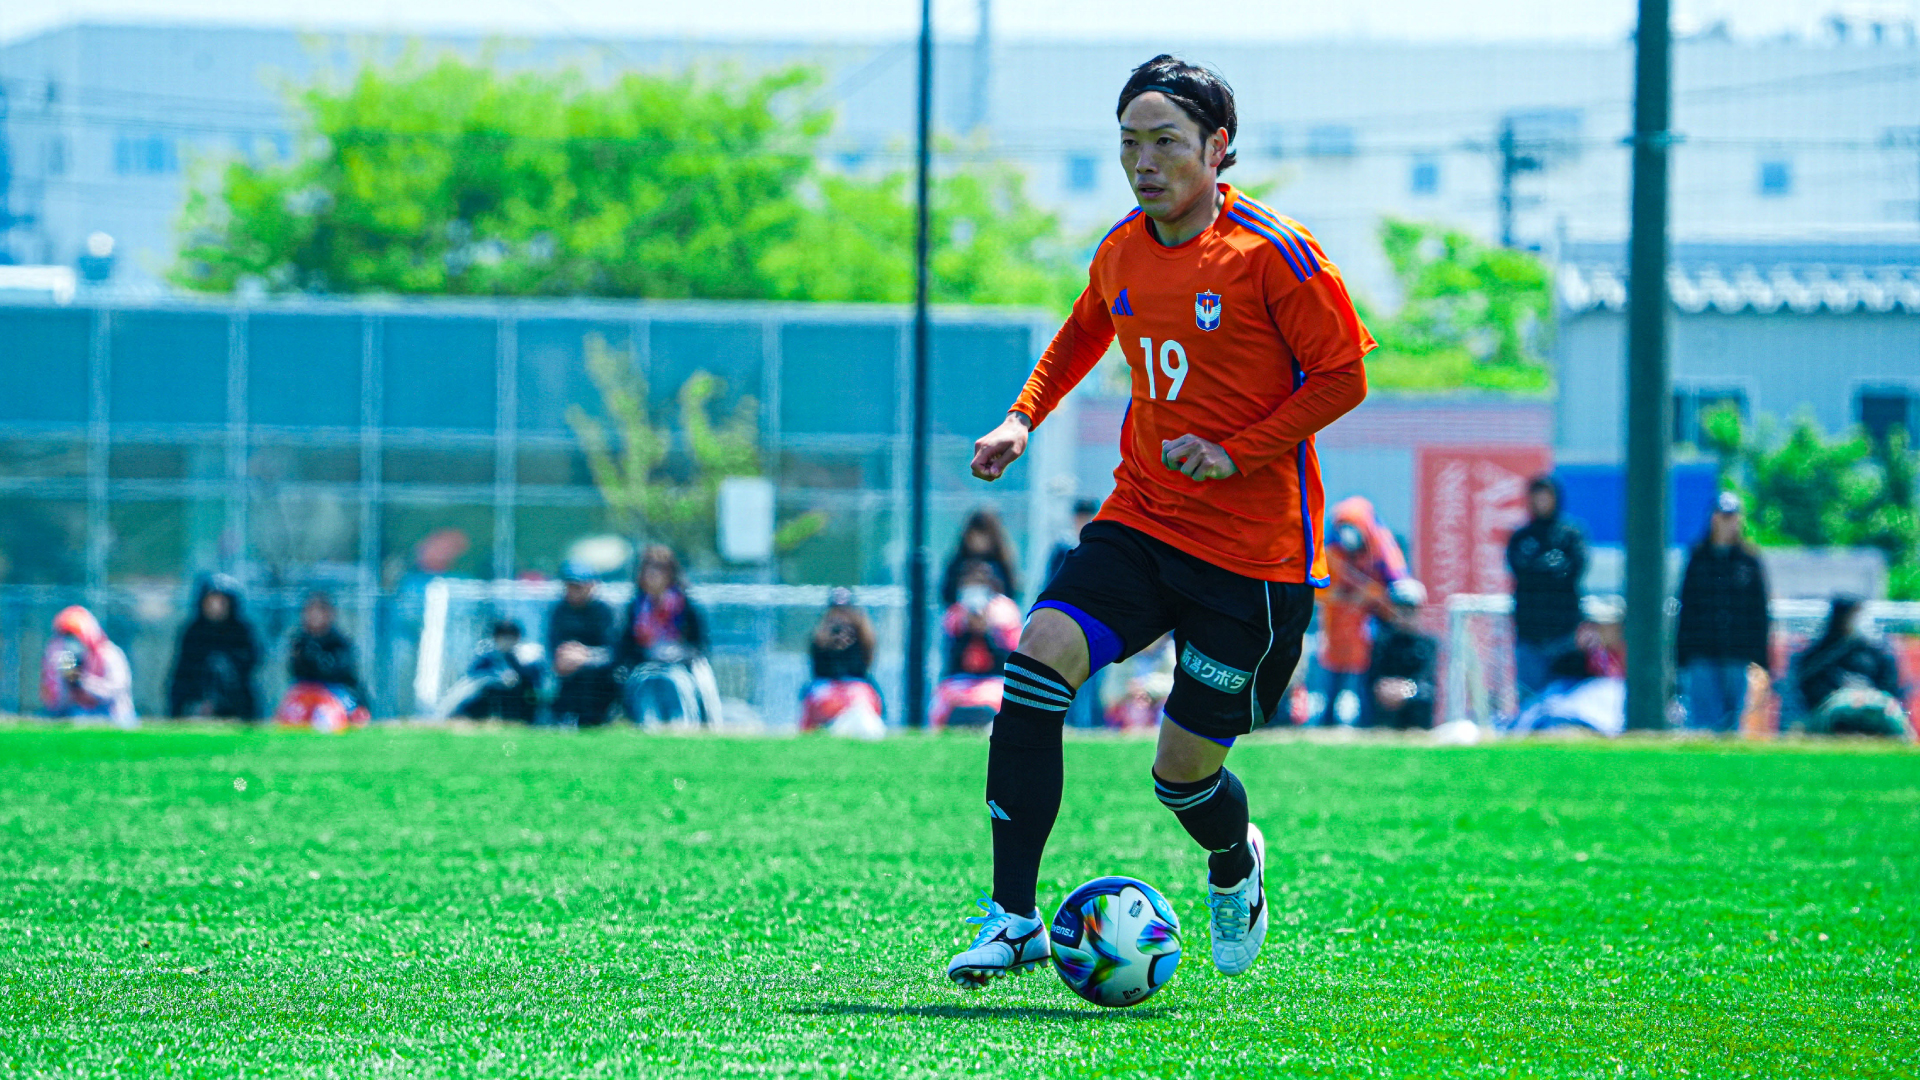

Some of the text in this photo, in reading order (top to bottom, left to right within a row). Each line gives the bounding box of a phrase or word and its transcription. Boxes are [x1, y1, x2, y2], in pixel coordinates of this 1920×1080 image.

[1140, 337, 1189, 401] 19
[1182, 648, 1246, 690] 新潟クボタ
